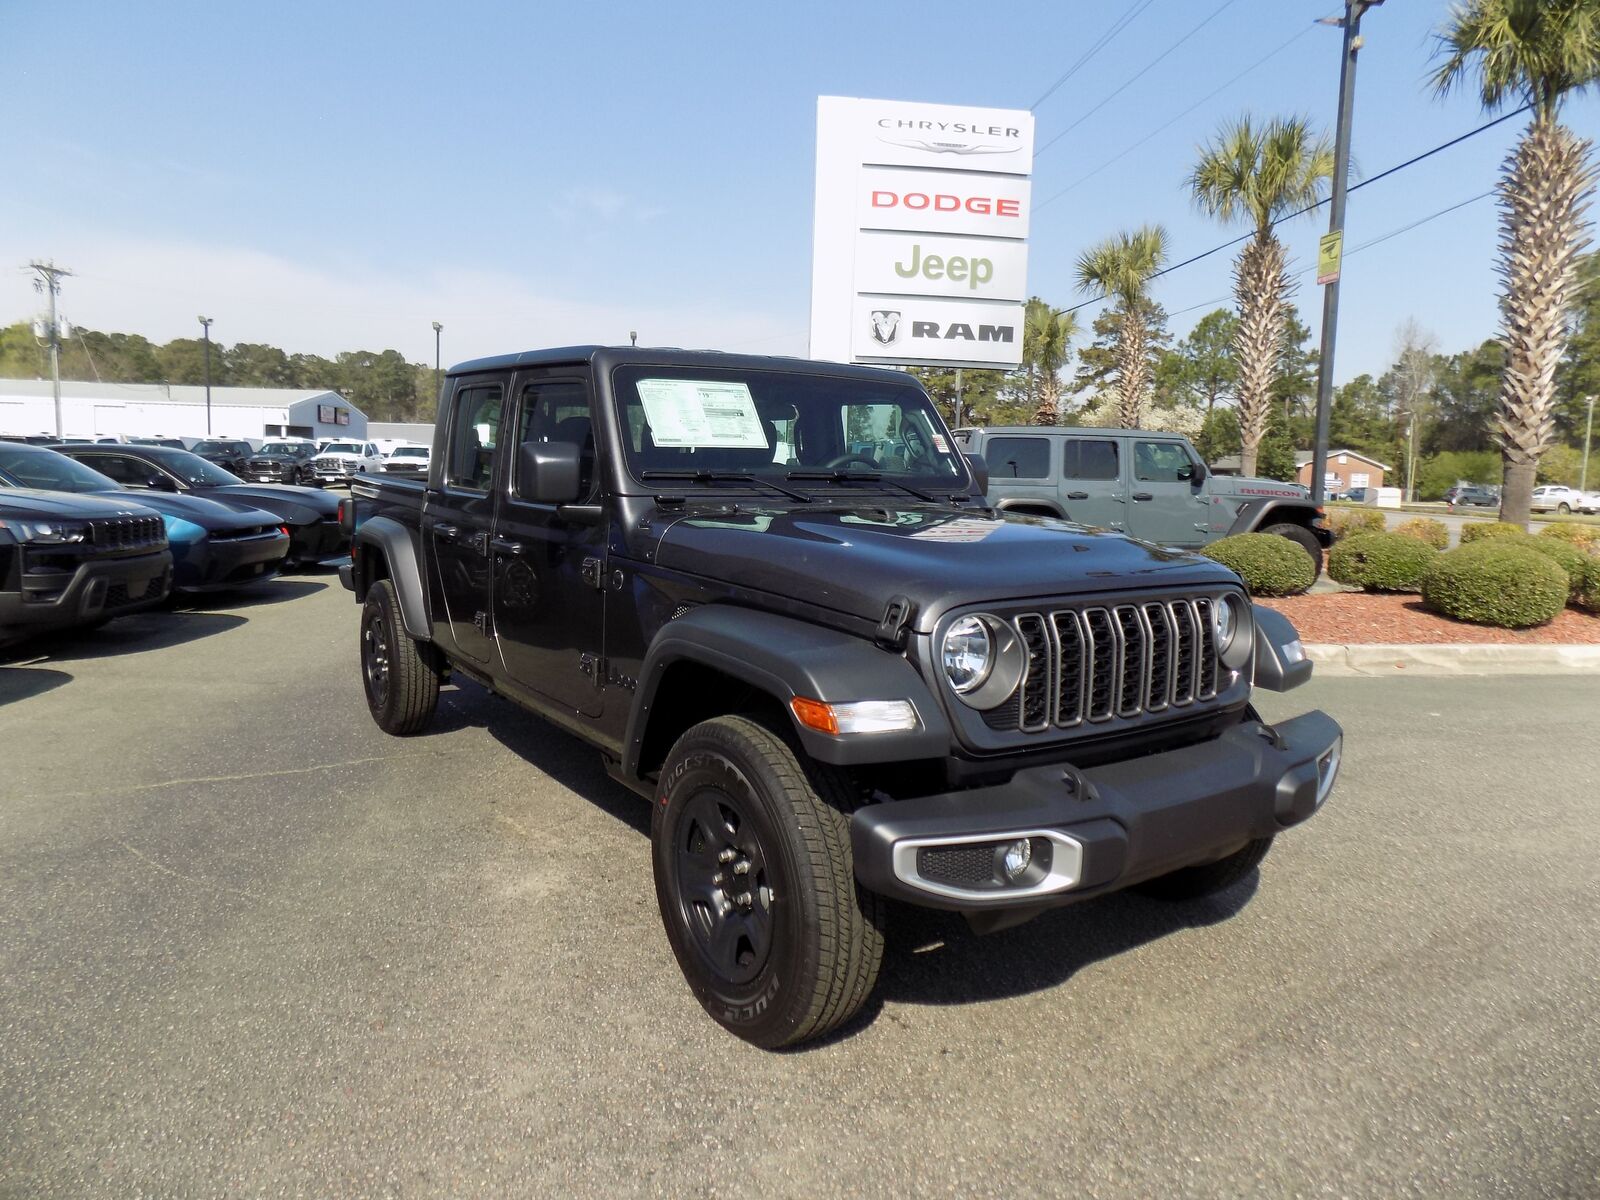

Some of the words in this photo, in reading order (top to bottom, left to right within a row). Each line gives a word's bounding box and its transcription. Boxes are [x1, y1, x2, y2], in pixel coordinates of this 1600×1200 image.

[877, 118, 1020, 138] CHRYSLER
[871, 190, 1020, 218] DODGE
[894, 244, 993, 290] Jeep
[911, 320, 1014, 343] RAM
[1240, 487, 1300, 498] RUBICON
